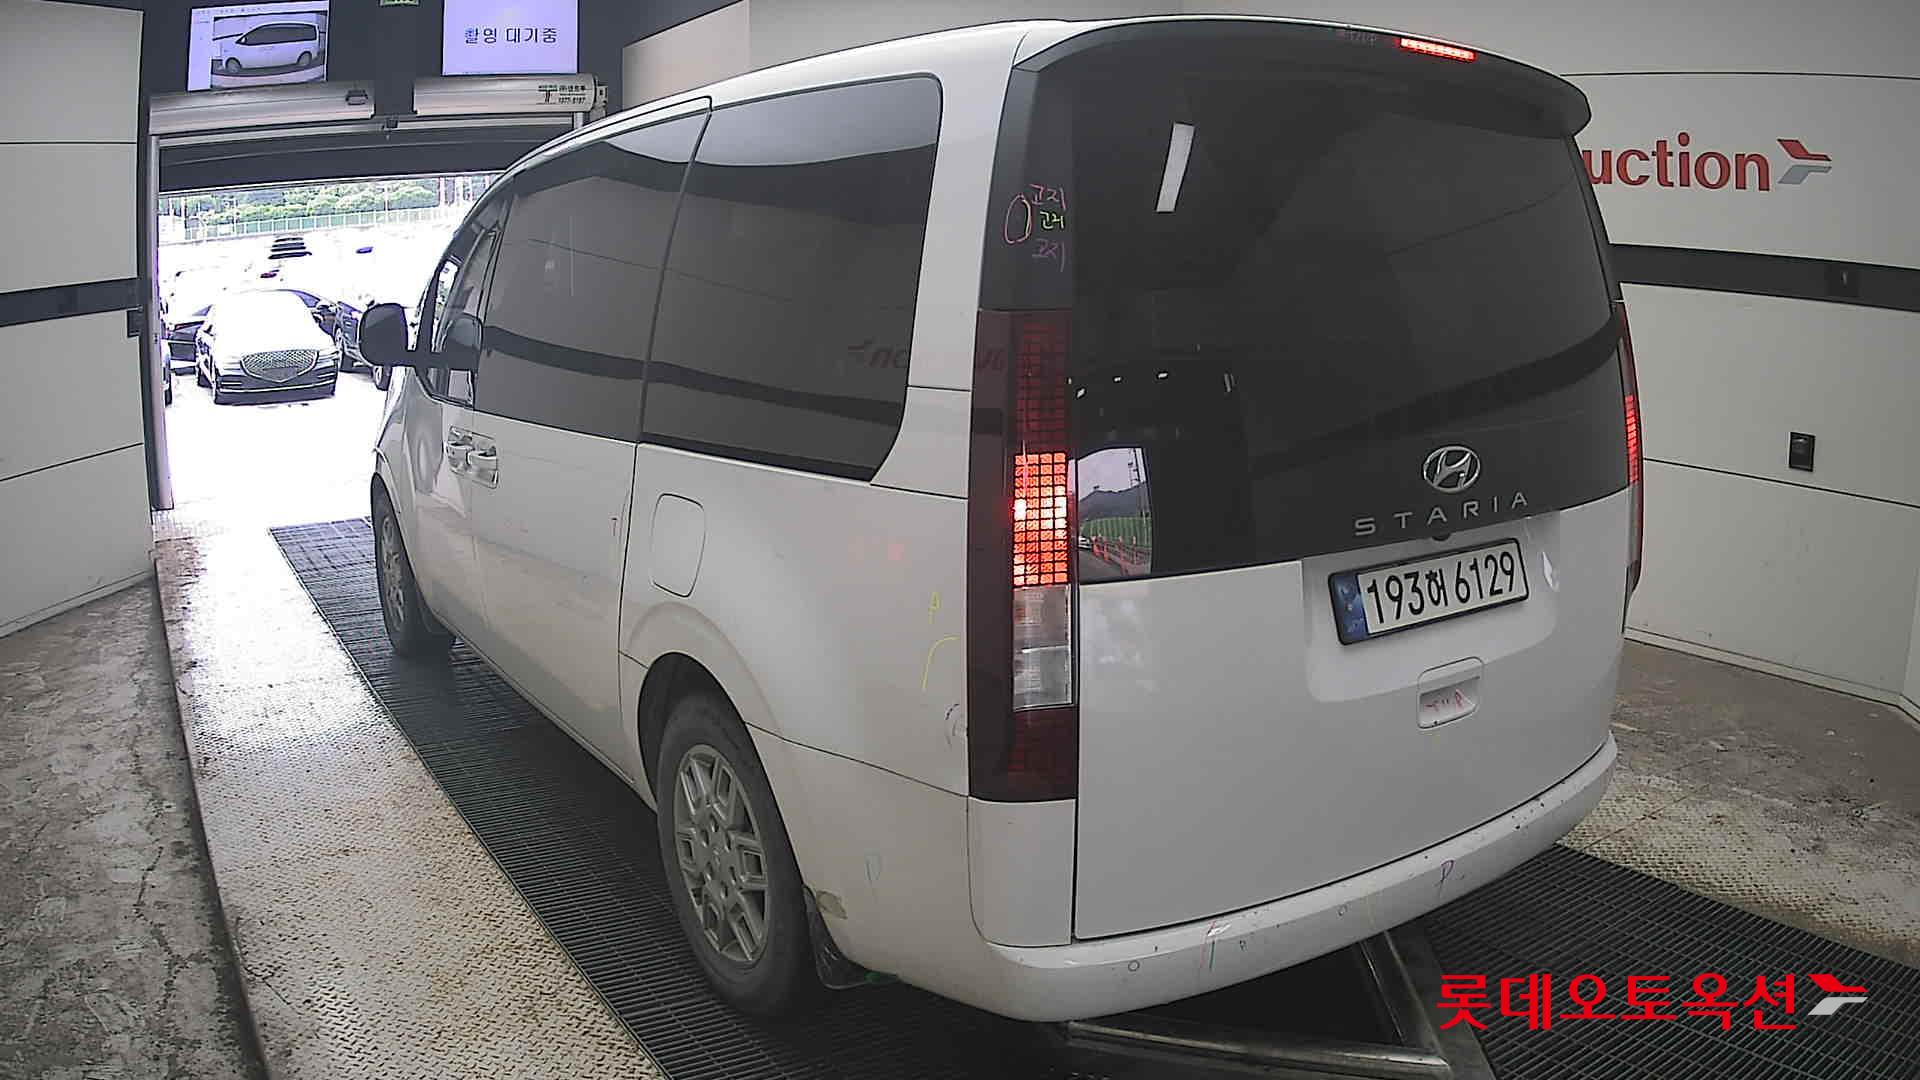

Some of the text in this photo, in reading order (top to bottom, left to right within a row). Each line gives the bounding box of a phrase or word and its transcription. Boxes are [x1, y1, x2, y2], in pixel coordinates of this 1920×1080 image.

[506, 27, 557, 44] 대기중
[1354, 492, 1528, 536] STARIA
[1367, 551, 1515, 624] 193허 6129
